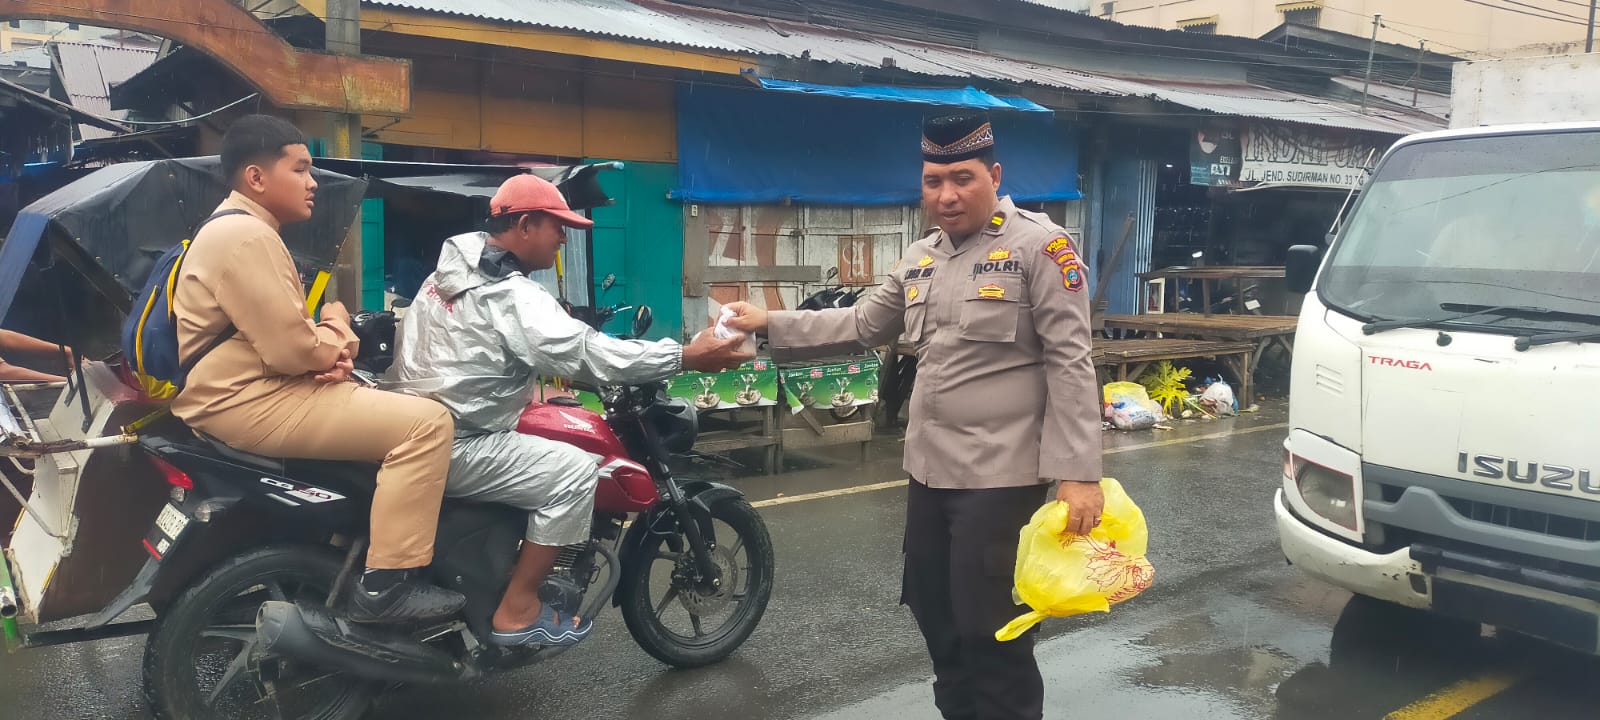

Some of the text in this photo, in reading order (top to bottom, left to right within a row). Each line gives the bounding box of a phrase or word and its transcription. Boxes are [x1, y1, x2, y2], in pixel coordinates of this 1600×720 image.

[1245, 170, 1258, 181] JL.
[1262, 170, 1285, 182] JEND.
[1287, 171, 1328, 183] SUDIRMAN
[1329, 173, 1343, 184] NO.
[1345, 174, 1353, 184] 33
[1368, 356, 1432, 371] TRAGA
[1458, 451, 1600, 494] ISUZU
